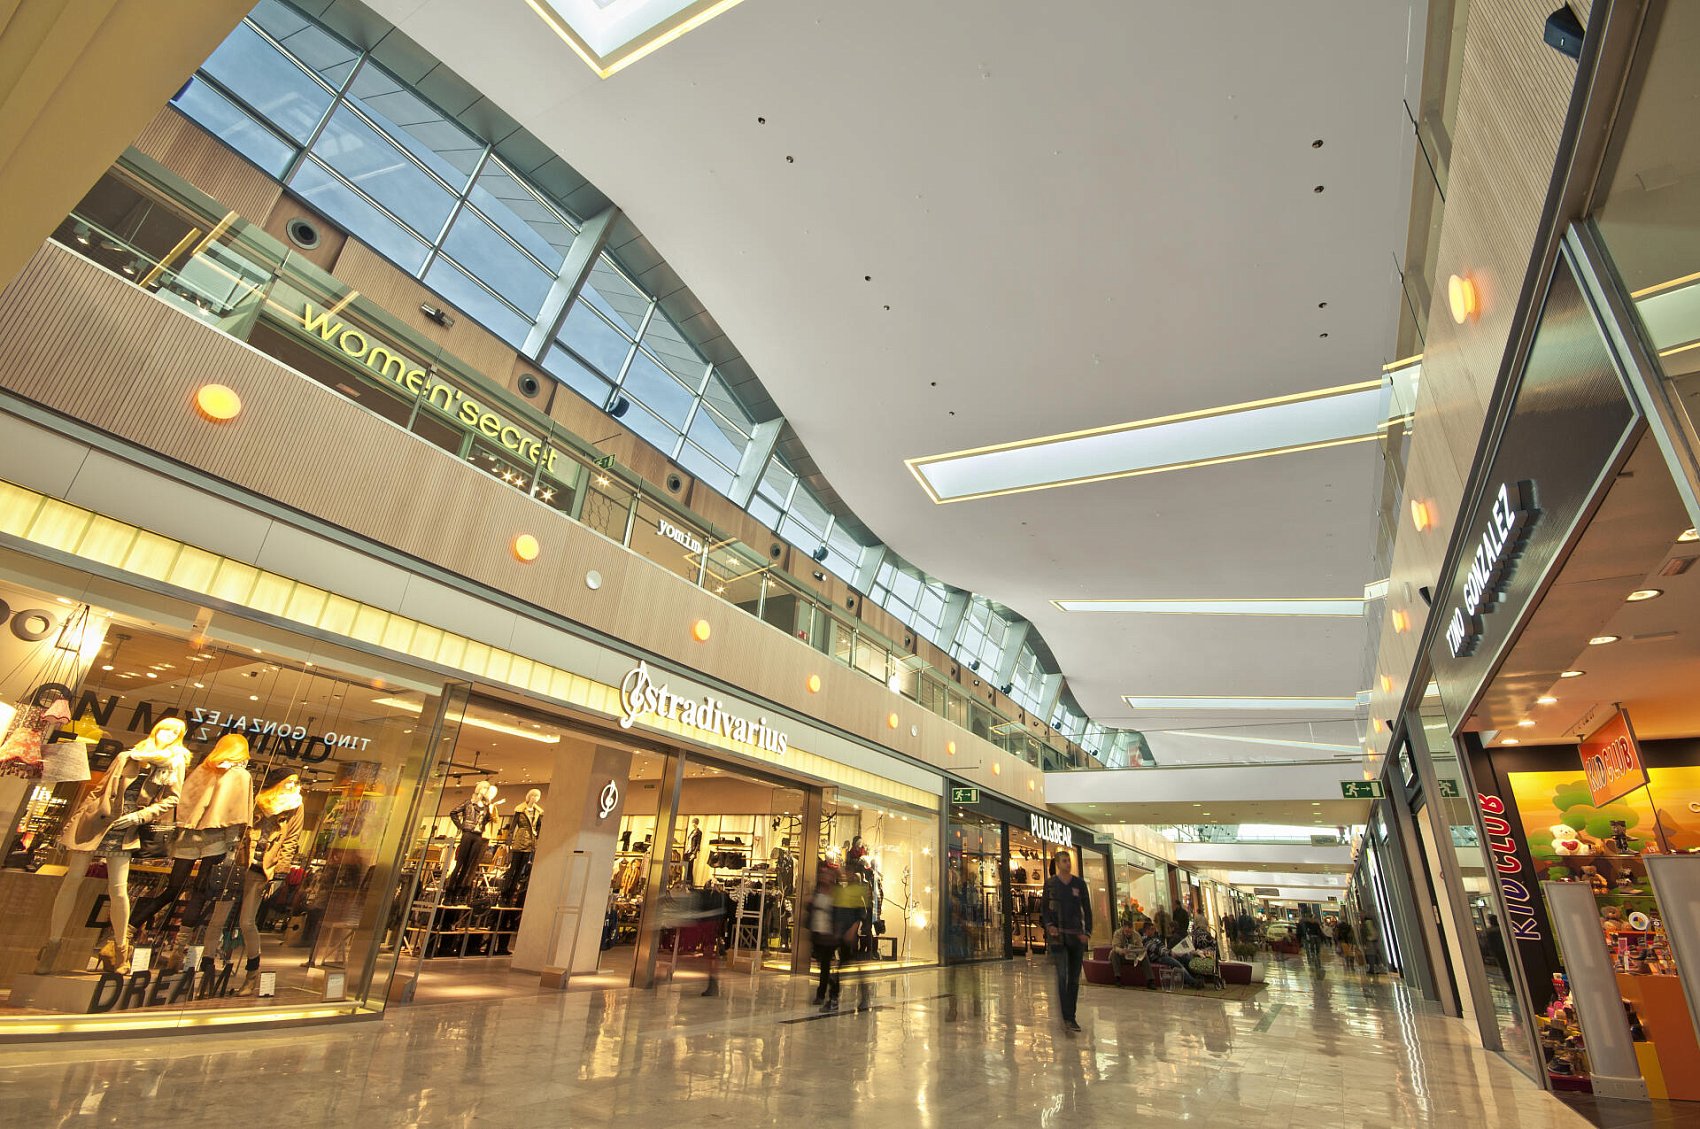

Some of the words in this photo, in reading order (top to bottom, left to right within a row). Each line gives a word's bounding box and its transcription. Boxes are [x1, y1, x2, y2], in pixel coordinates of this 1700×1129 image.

[1446, 606, 1466, 659] TINO
[1463, 482, 1516, 616] GONZALEZ
[638, 678, 788, 756] stradivarius
[1586, 755, 1607, 792] KID
[1603, 736, 1633, 783] CLUB
[1030, 813, 1073, 849] PULL&BEAR
[1477, 792, 1522, 874] CLUB
[1500, 876, 1541, 941] KID
[86, 962, 234, 1015] DREAM
